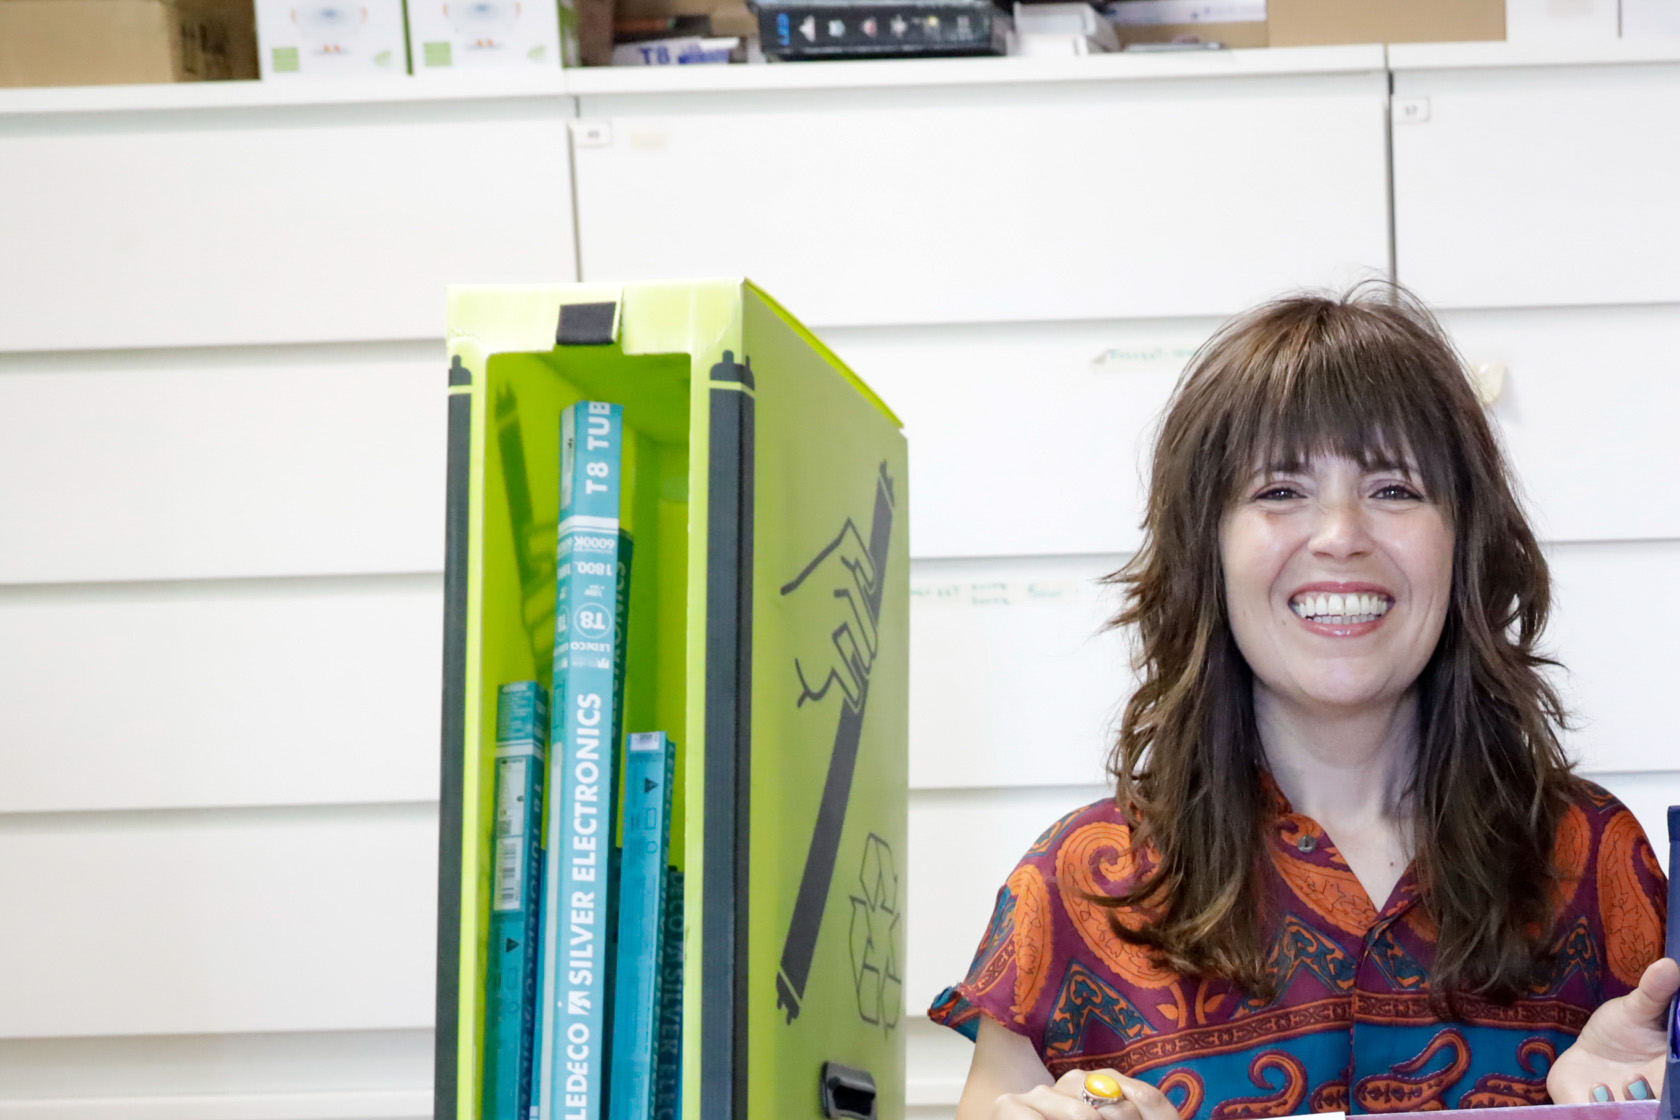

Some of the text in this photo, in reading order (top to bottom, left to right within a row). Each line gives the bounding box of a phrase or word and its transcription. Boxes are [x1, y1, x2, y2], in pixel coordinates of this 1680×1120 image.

[585, 461, 609, 494] T8
[580, 611, 606, 630] T8
[570, 641, 611, 652] LEDECO
[572, 692, 603, 882] ELECTRONICS
[567, 891, 596, 986] SILVER
